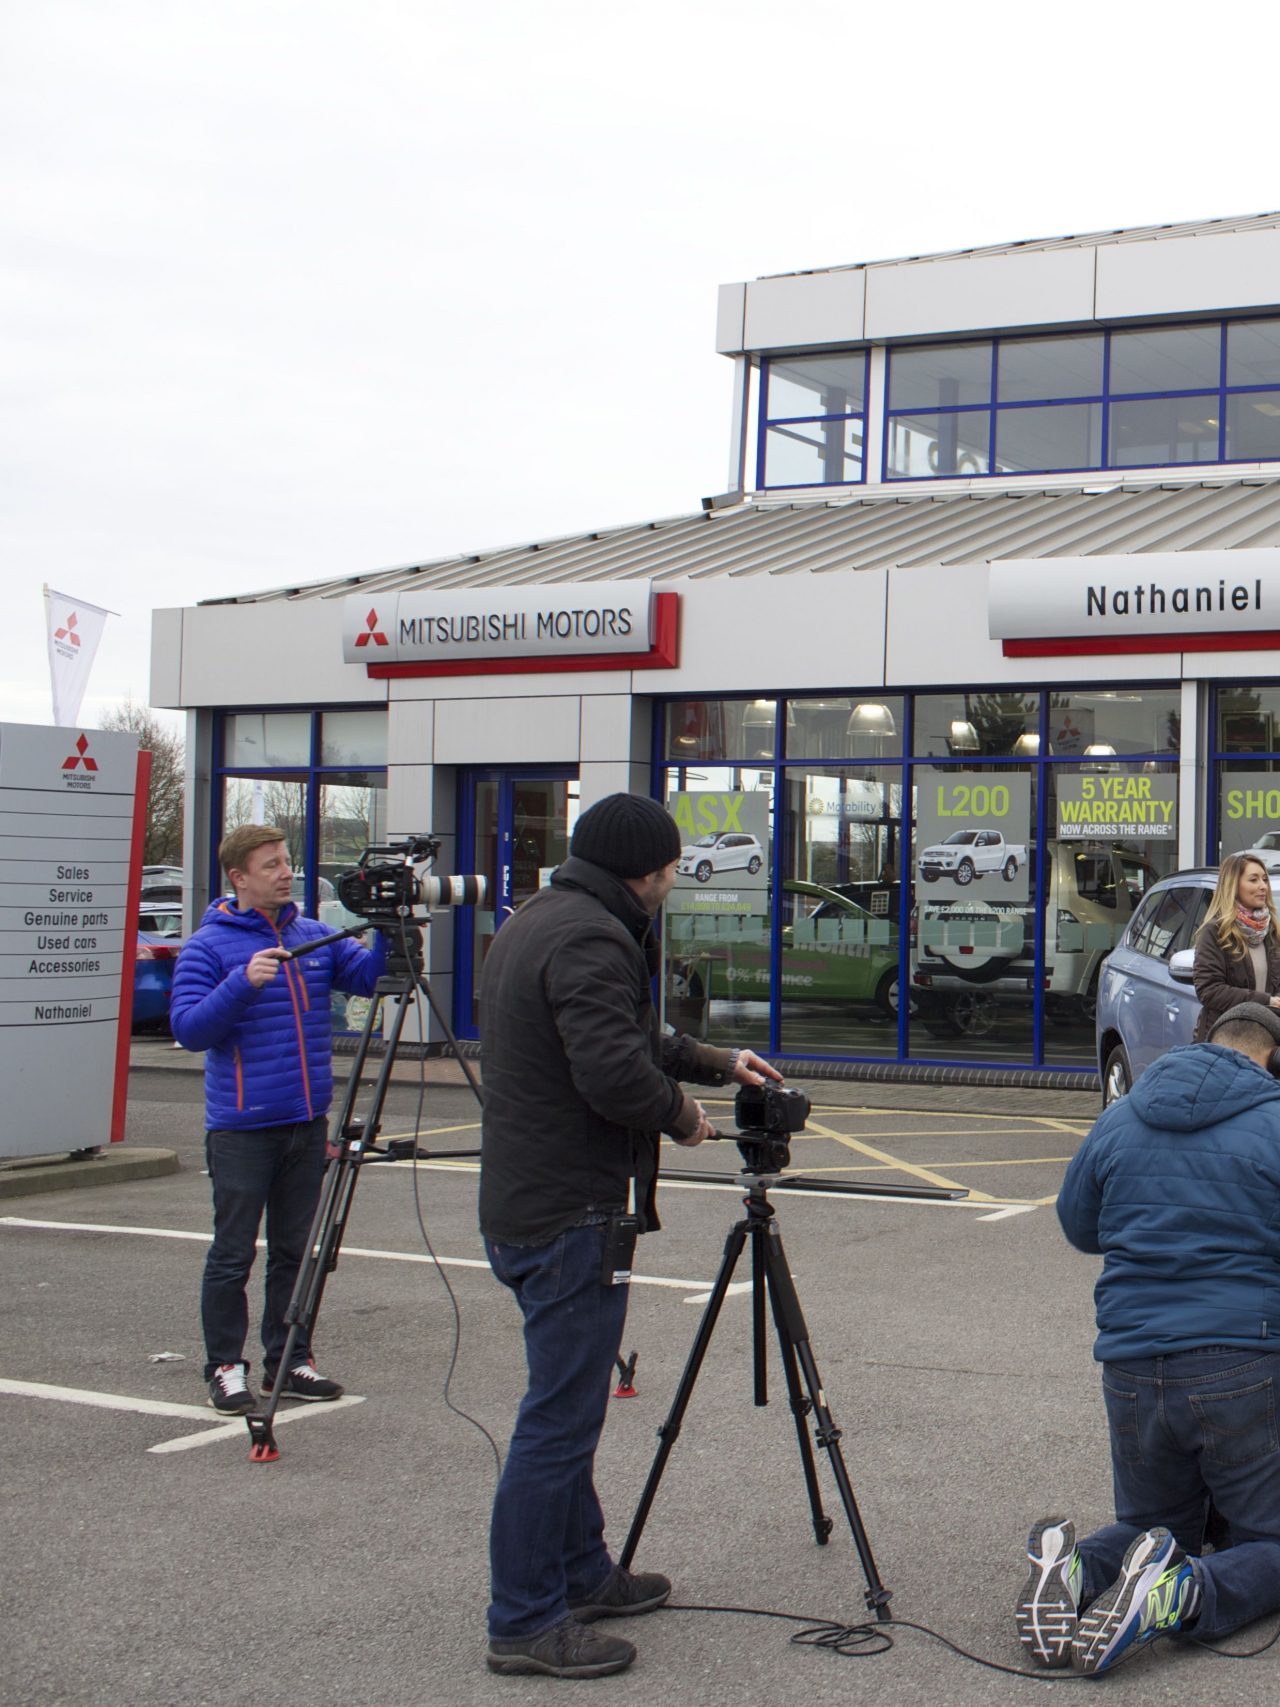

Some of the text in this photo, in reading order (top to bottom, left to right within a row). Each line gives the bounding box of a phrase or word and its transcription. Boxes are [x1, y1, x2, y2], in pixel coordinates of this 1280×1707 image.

[1087, 579, 1262, 617] Nathaniel
[400, 607, 633, 645] MITSUBISHI MOTORS
[62, 773, 96, 782] MITSUBISHI
[67, 781, 92, 790] MOTORS
[1081, 776, 1152, 799] 5 YEAR
[826, 801, 877, 814] Moability
[937, 785, 1009, 817] L200
[674, 794, 744, 837] ASX
[1060, 800, 1174, 823] WARRANTY
[1060, 824, 1081, 835] NOW
[1082, 824, 1118, 835] ACROSS
[1119, 824, 1137, 835] THE
[56, 866, 90, 880] Sales
[49, 888, 93, 903] Service
[24, 911, 109, 929] Genuine parts
[37, 936, 97, 950] Used cars
[28, 957, 101, 973] Accessories
[35, 1003, 92, 1020] Nathaniel
